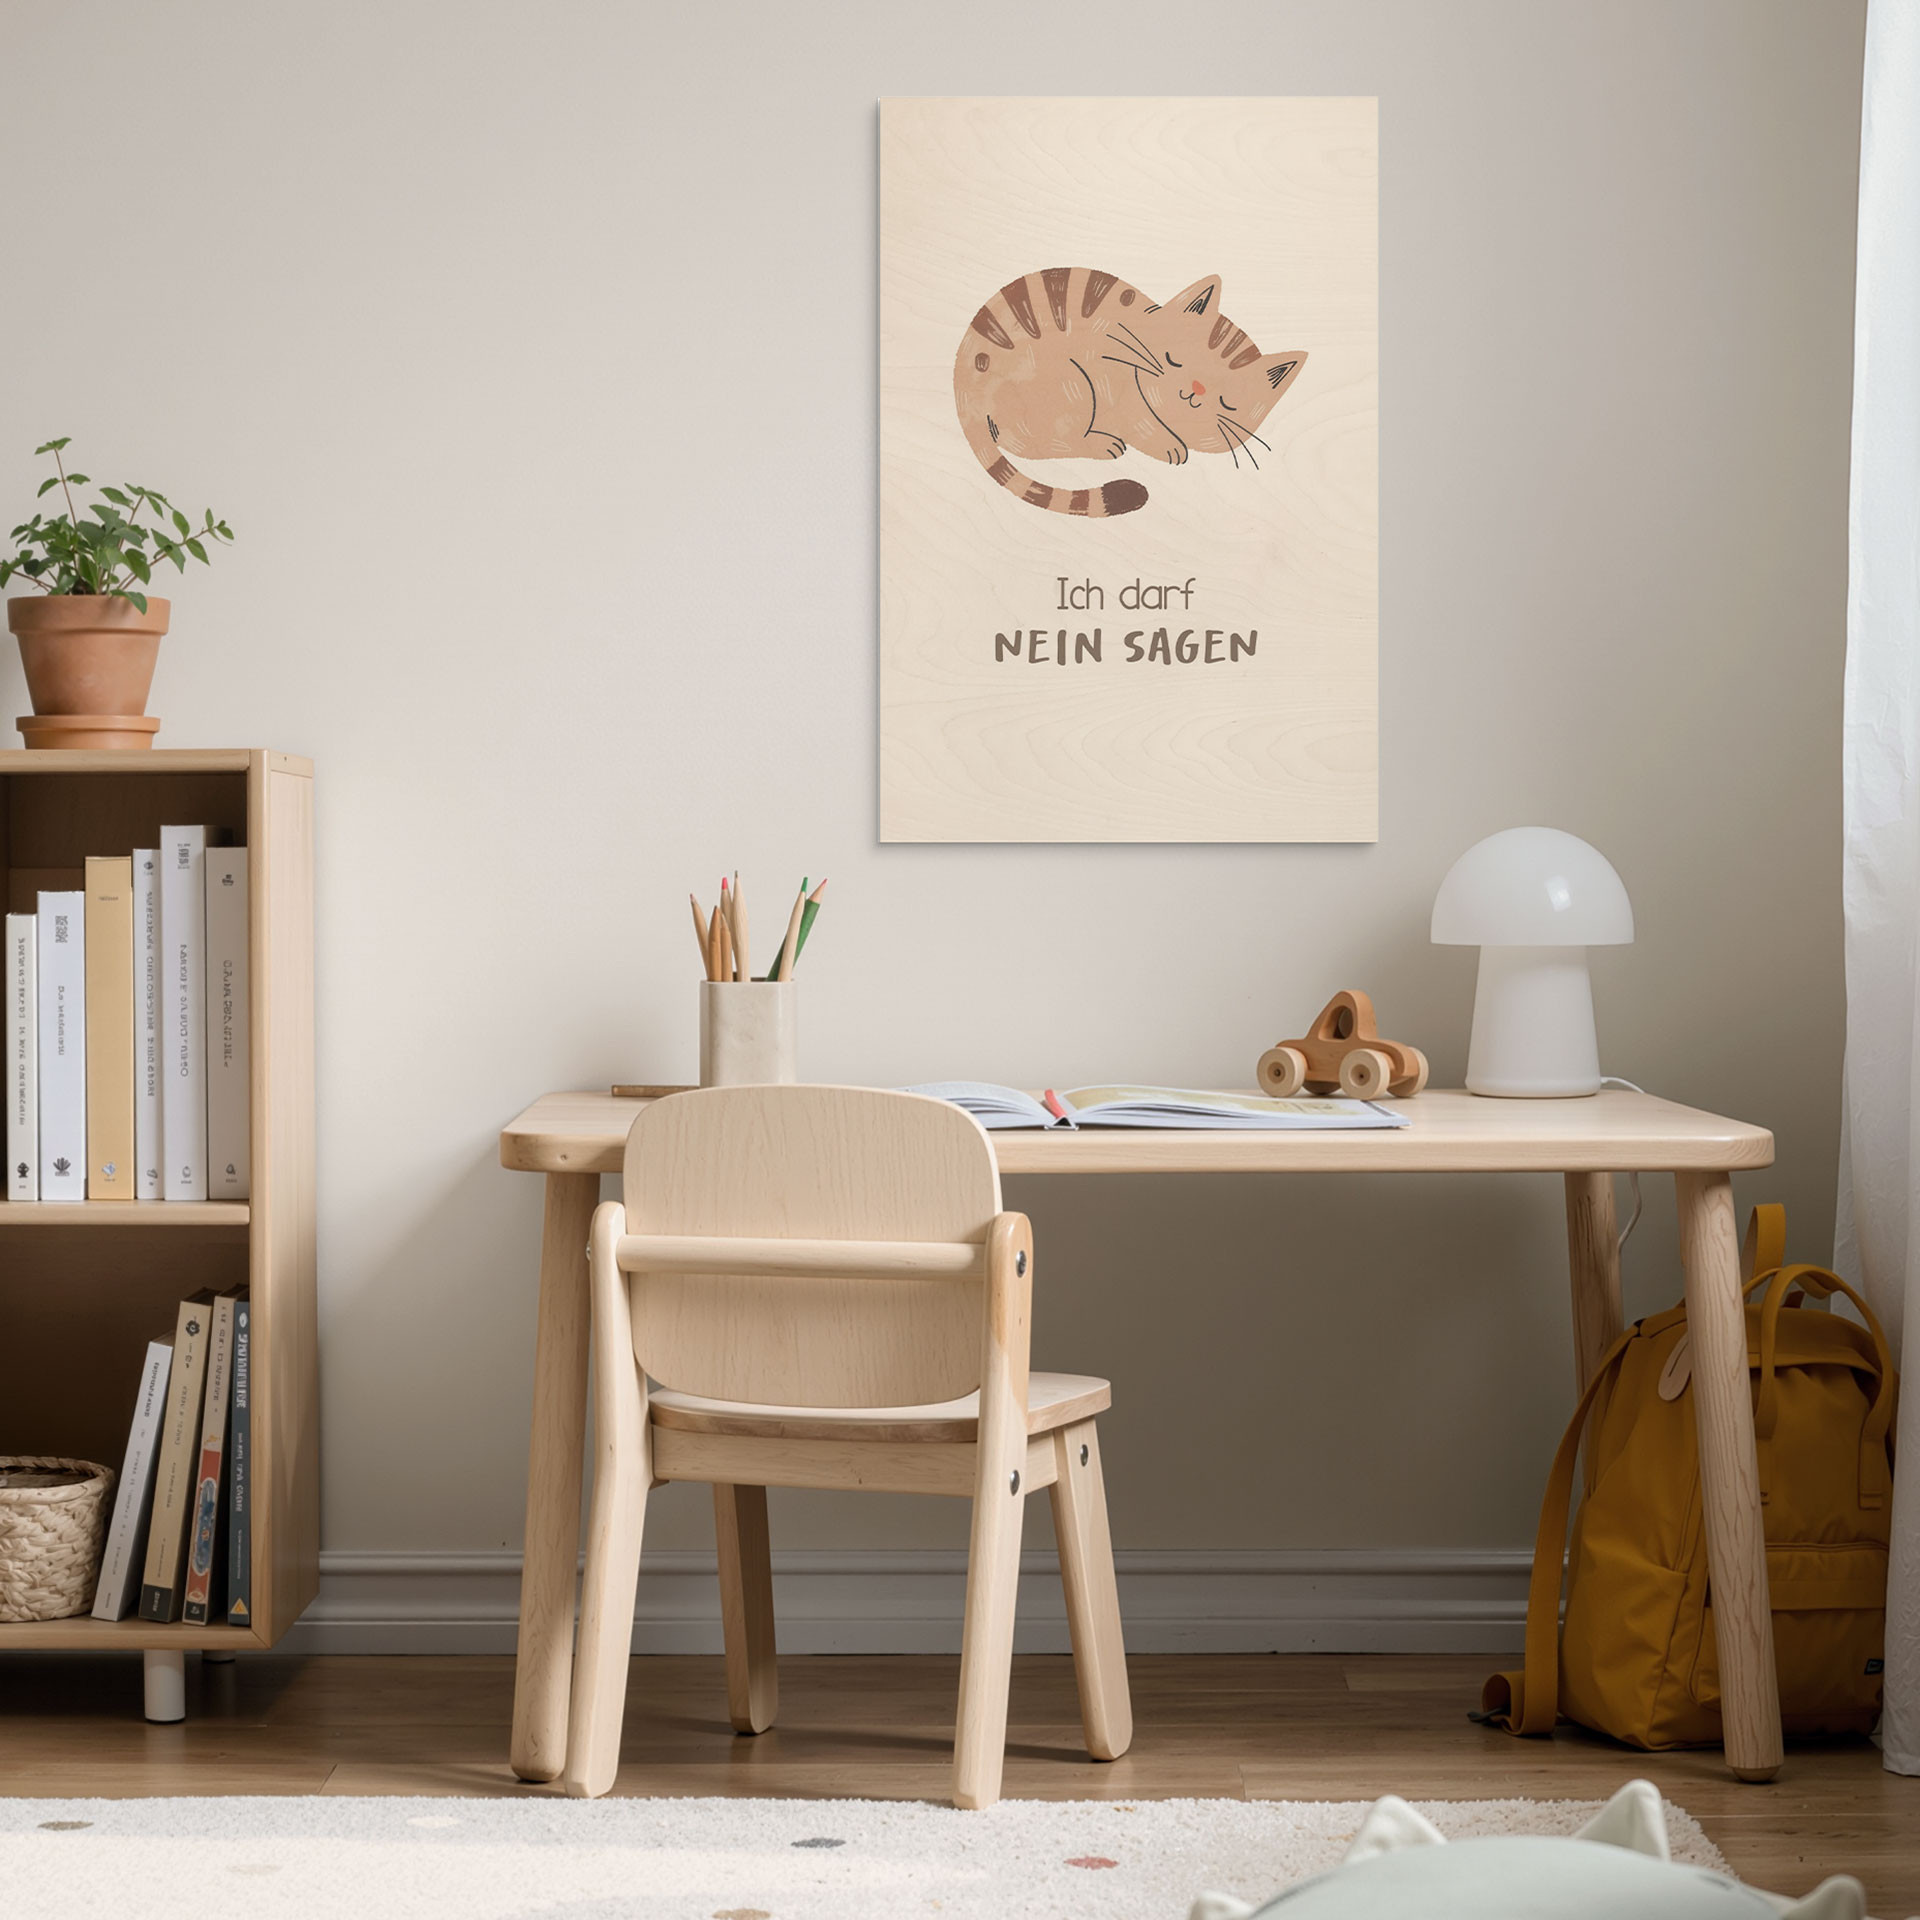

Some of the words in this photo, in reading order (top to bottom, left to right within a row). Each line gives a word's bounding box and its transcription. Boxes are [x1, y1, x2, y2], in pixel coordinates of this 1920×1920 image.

[1056, 577, 1104, 610] Ich
[1119, 577, 1196, 610] darf
[995, 627, 1102, 666] NEIN
[1123, 627, 1258, 666] SAGEN
